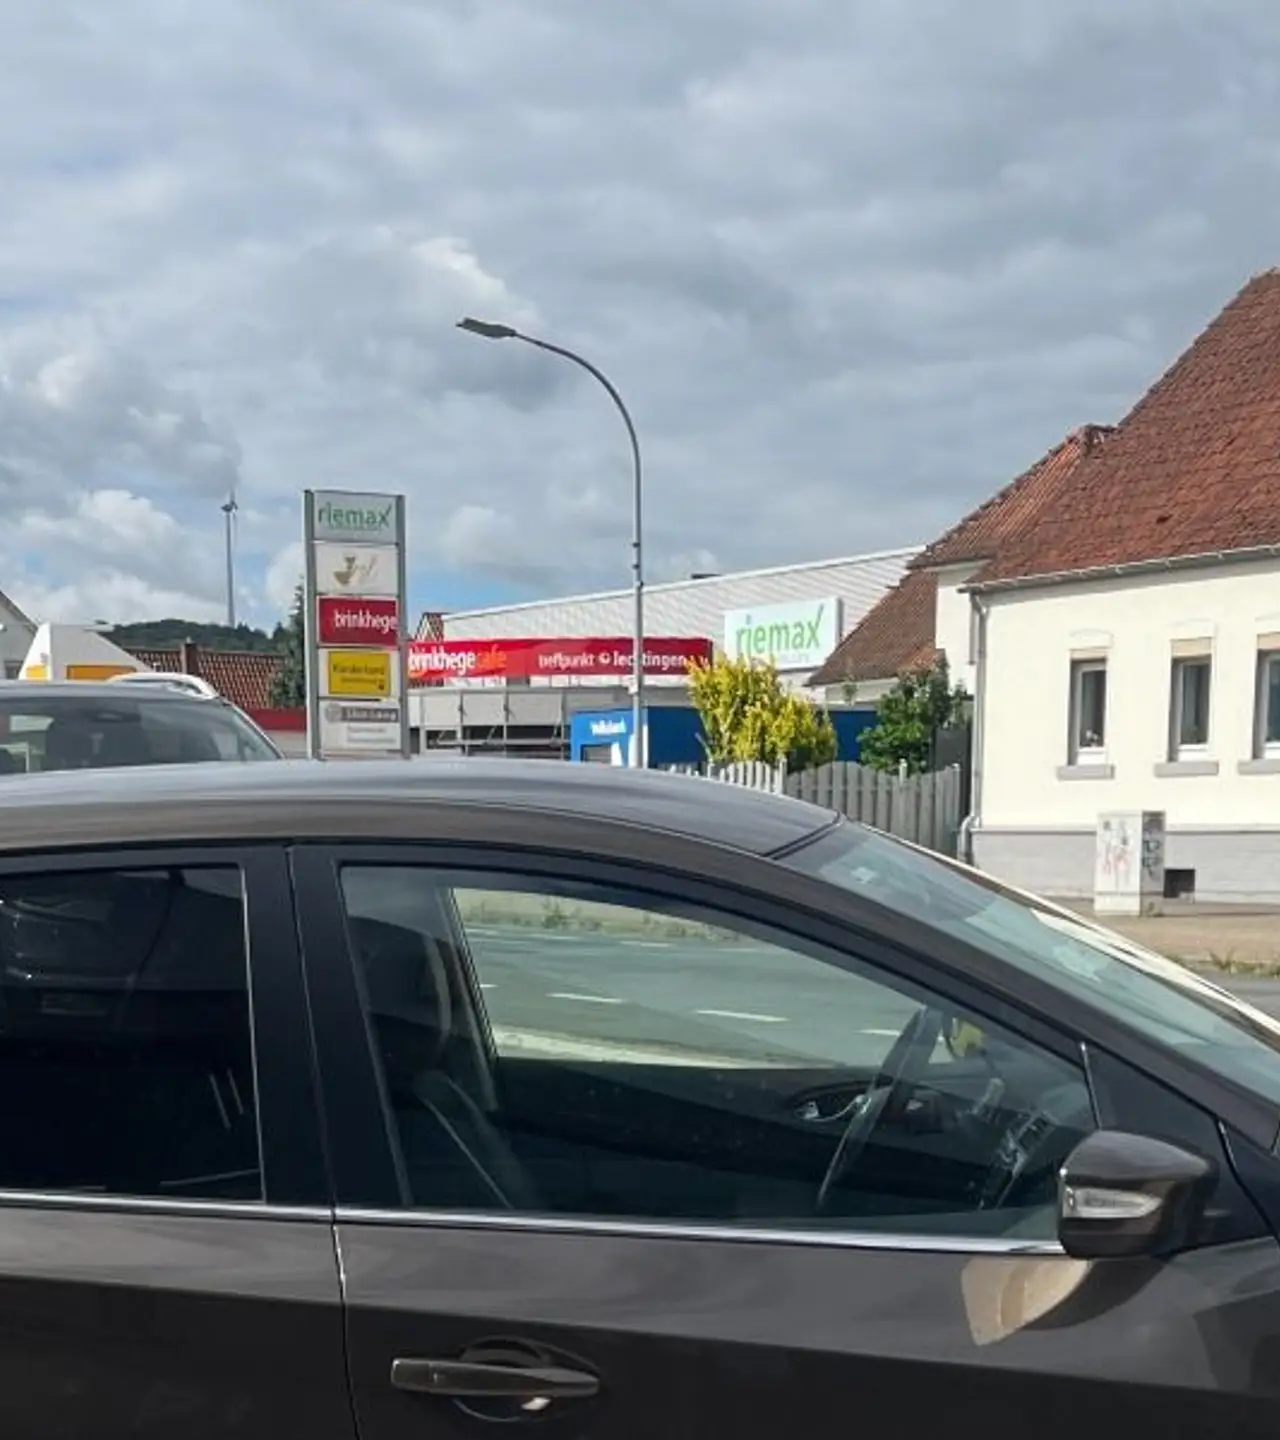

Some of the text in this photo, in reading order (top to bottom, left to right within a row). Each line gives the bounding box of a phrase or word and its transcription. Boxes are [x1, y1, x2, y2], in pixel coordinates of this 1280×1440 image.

[318, 502, 392, 528] riemax
[333, 608, 398, 635] brinkhege
[735, 602, 825, 658] riemax
